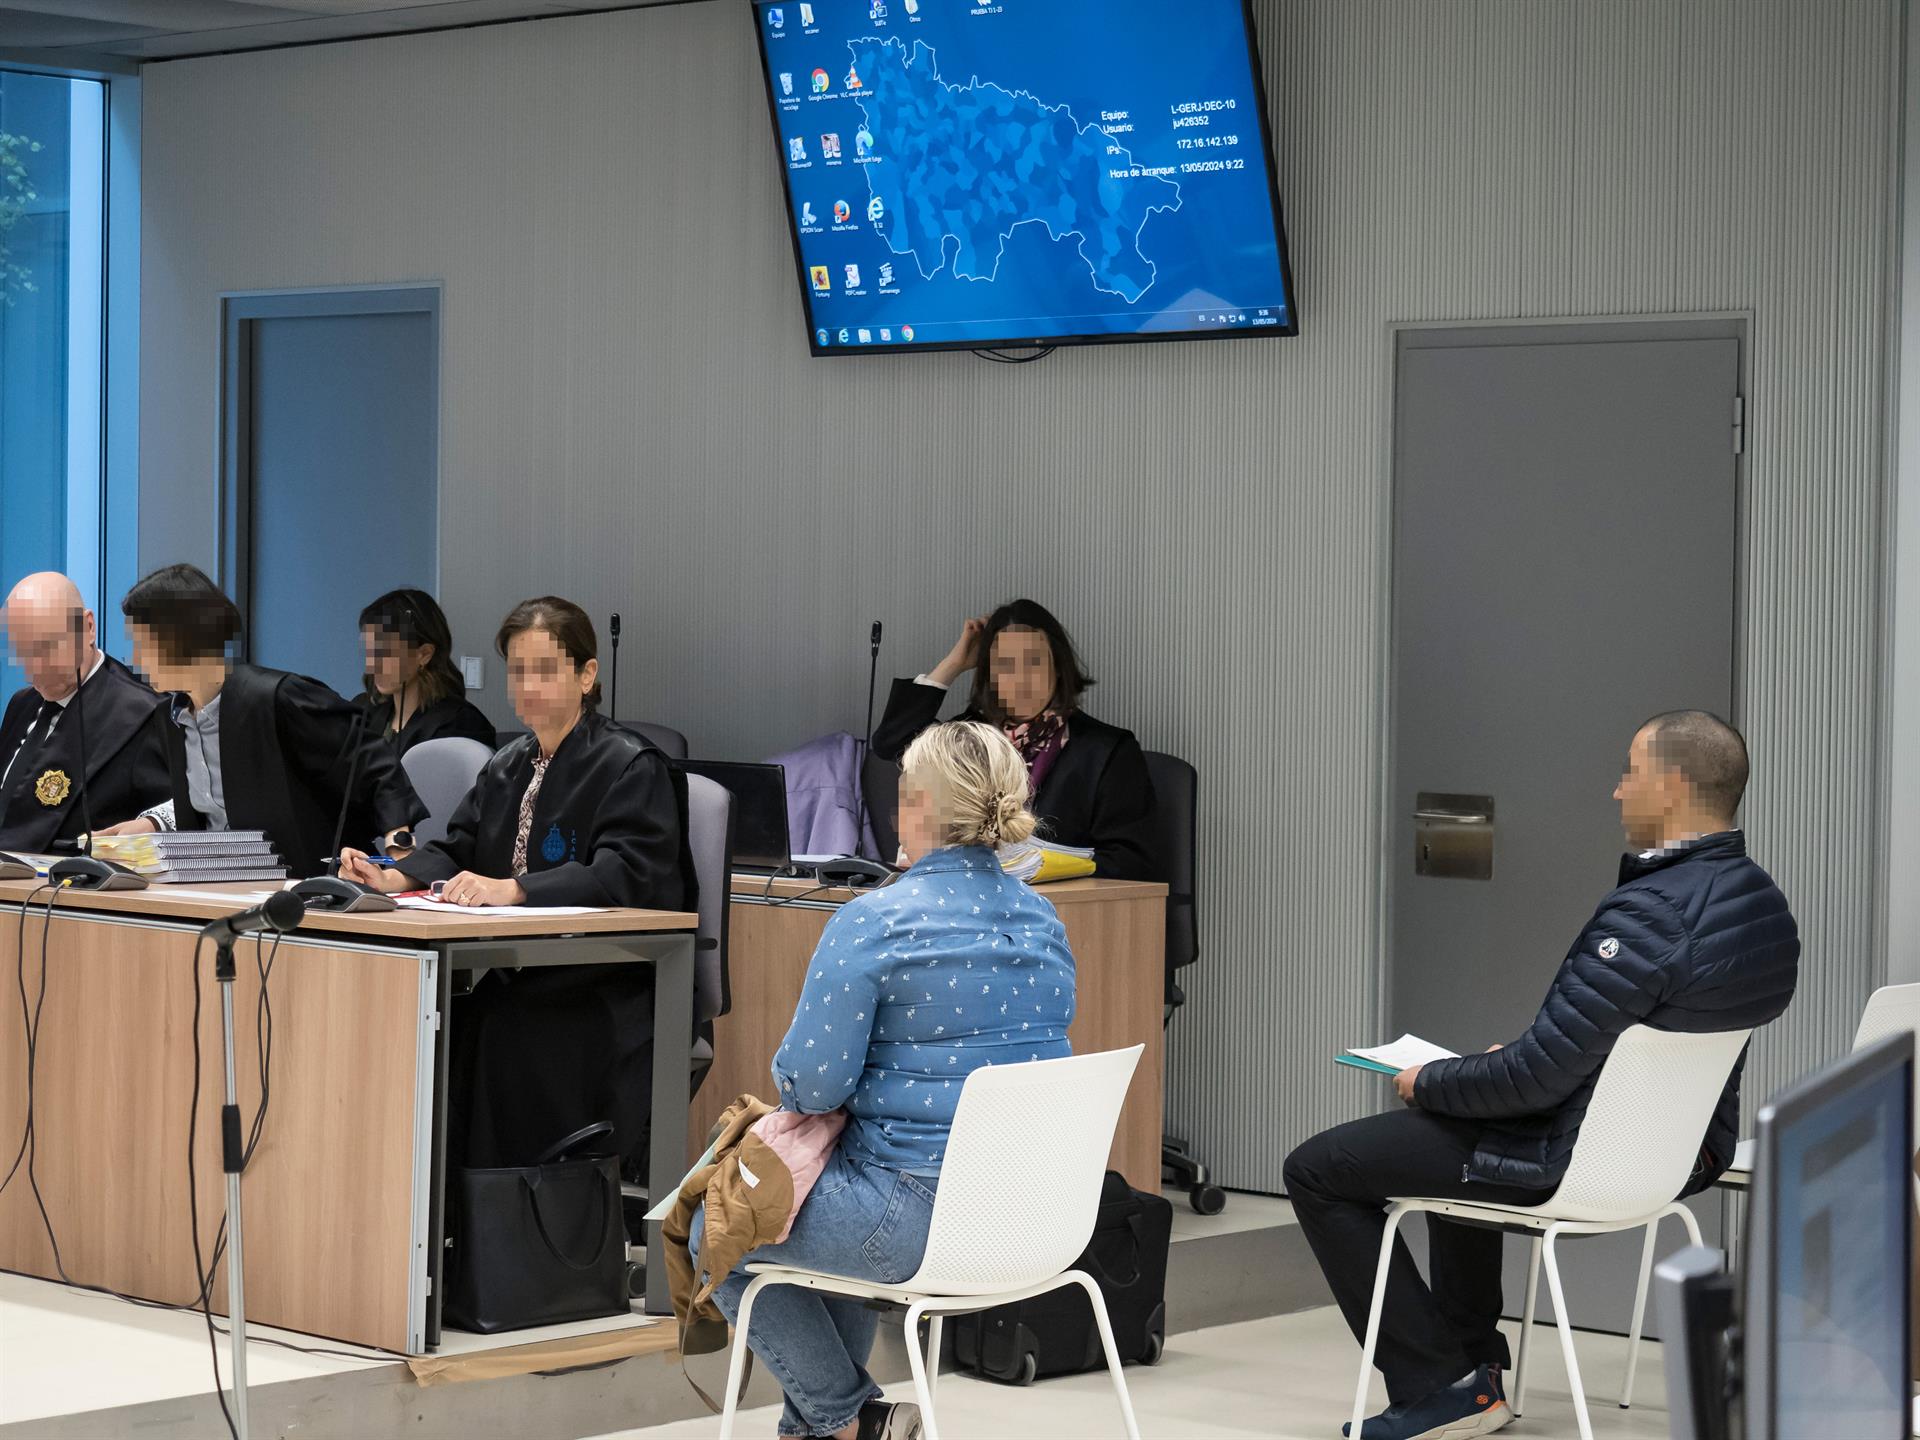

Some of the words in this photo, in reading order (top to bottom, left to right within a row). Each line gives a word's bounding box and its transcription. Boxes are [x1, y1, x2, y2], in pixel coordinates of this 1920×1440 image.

[808, 94, 822, 102] Google
[1171, 99, 1236, 114] L-GERJ-DEC-10
[1101, 110, 1129, 122] Equipo:
[1103, 124, 1134, 134] Usuario:
[1176, 135, 1238, 149] 172.16.142.139
[1106, 146, 1122, 155] IPs:
[1110, 170, 1129, 178] Hora
[1130, 167, 1140, 176] de
[1142, 165, 1177, 176] arranque:
[1180, 161, 1224, 173] 13/05/2024
[1226, 159, 1244, 169] 9:22
